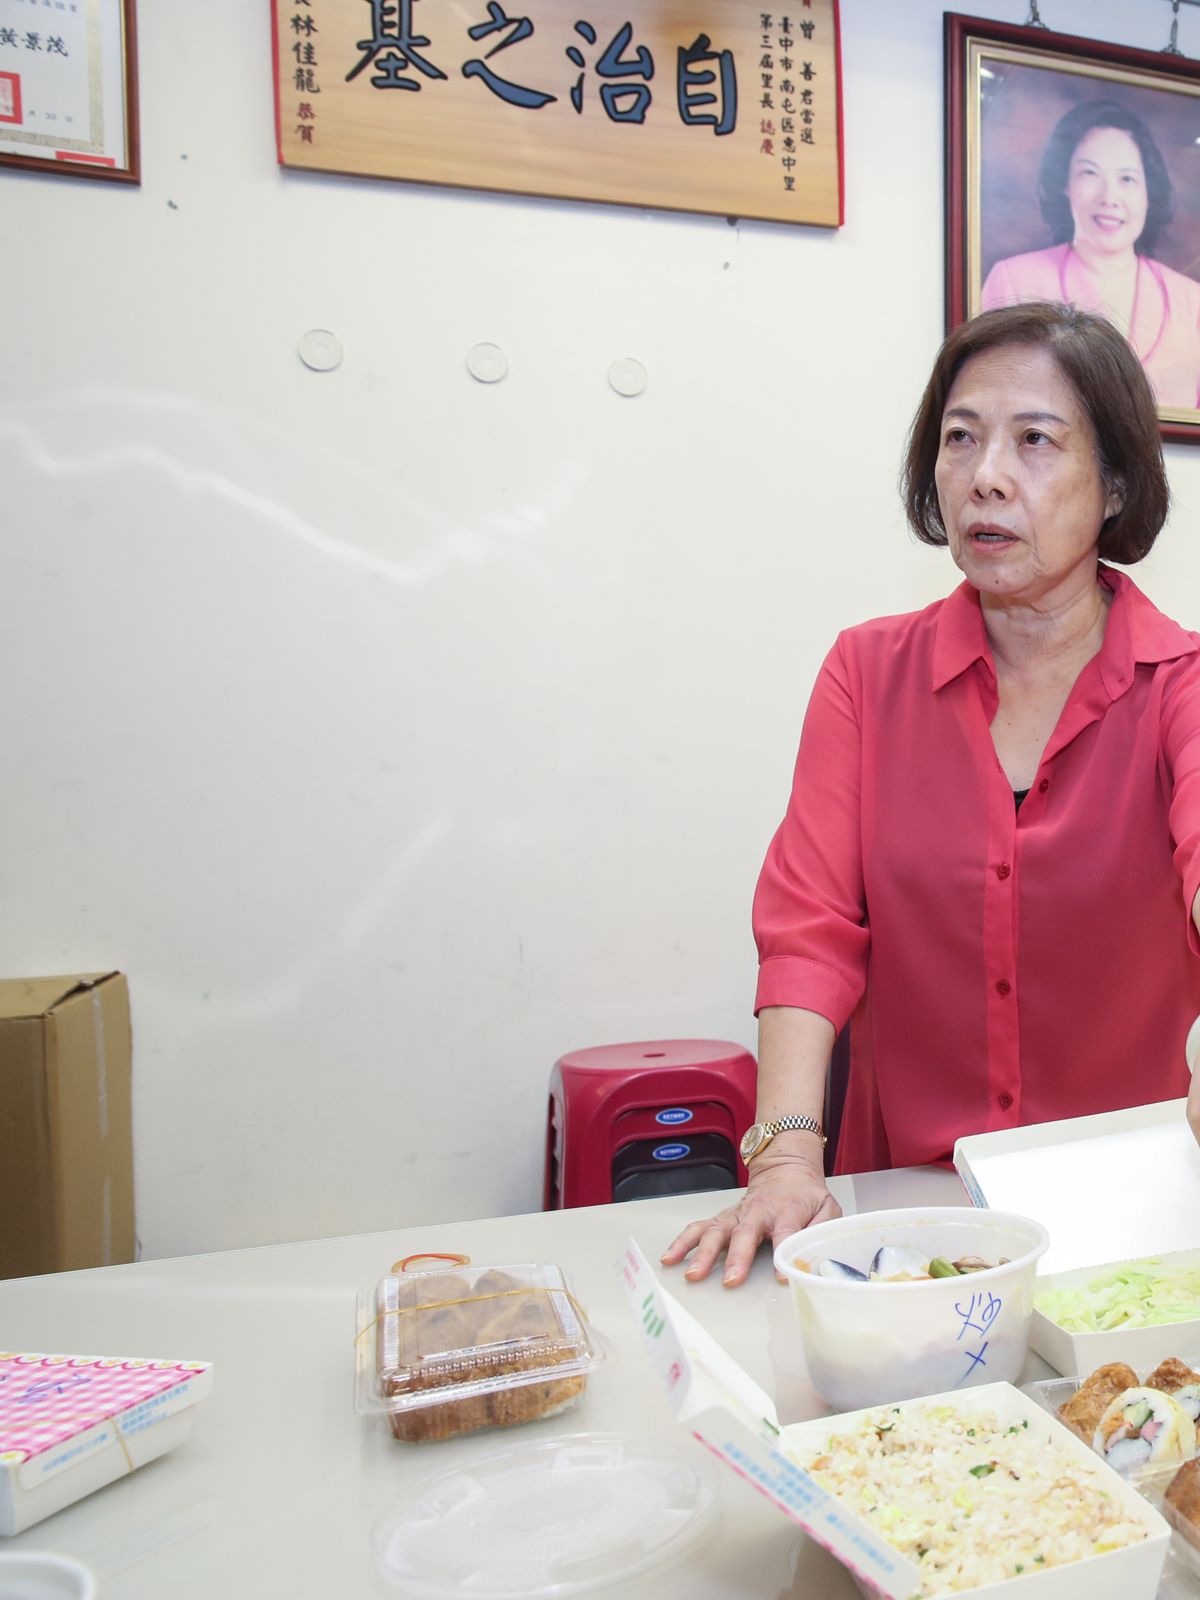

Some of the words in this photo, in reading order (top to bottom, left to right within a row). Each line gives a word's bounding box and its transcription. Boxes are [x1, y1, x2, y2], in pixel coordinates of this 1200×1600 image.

[290, 0, 321, 144] 林佳龍恭賀
[345, 0, 738, 137] 自治之基
